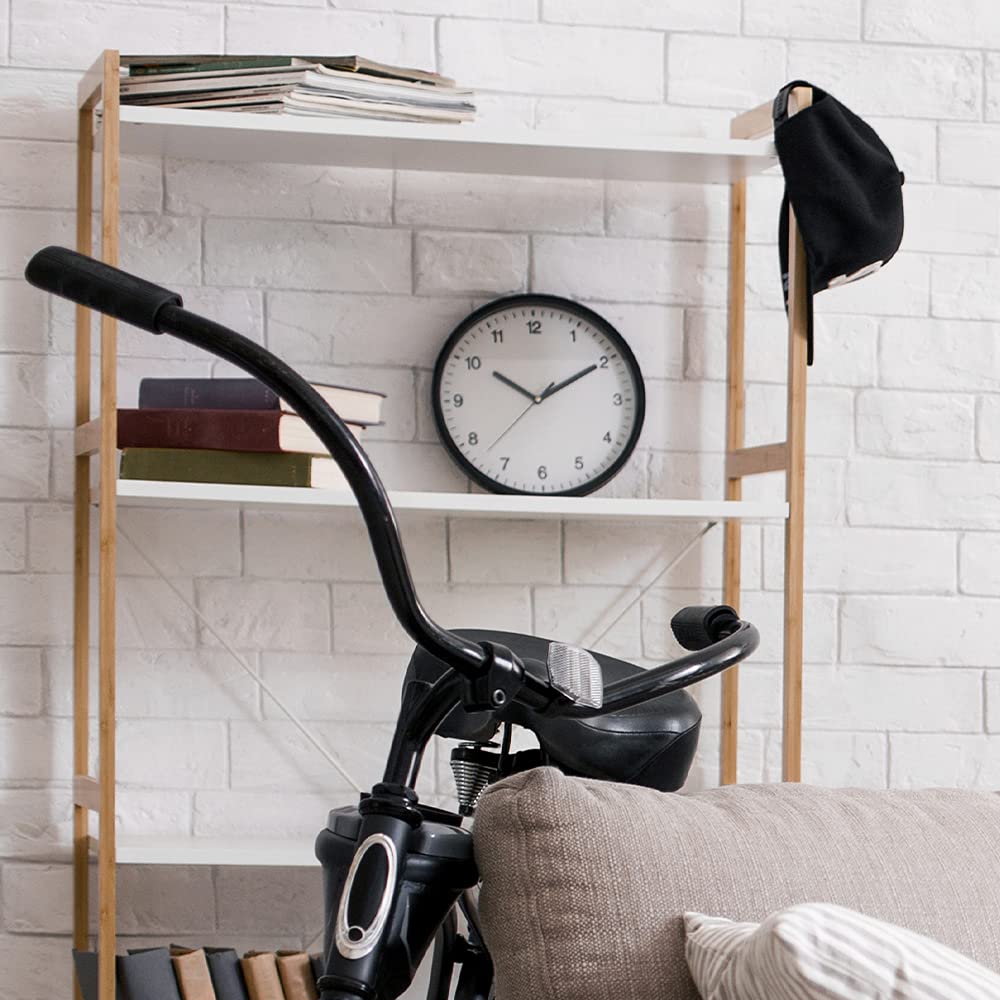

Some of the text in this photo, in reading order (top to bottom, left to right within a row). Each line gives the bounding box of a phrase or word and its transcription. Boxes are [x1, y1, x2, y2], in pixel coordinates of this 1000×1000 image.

[526, 320, 542, 335] 12
[491, 330, 504, 343] 11
[570, 331, 577, 343] 1
[465, 356, 481, 370] 10
[599, 355, 609, 369] 2
[453, 393, 464, 408] 9
[612, 393, 623, 407] 3
[468, 432, 478, 446] 8
[602, 431, 612, 444] 4
[500, 457, 510, 471] 7
[574, 456, 584, 470] 5
[537, 465, 548, 480] 6
